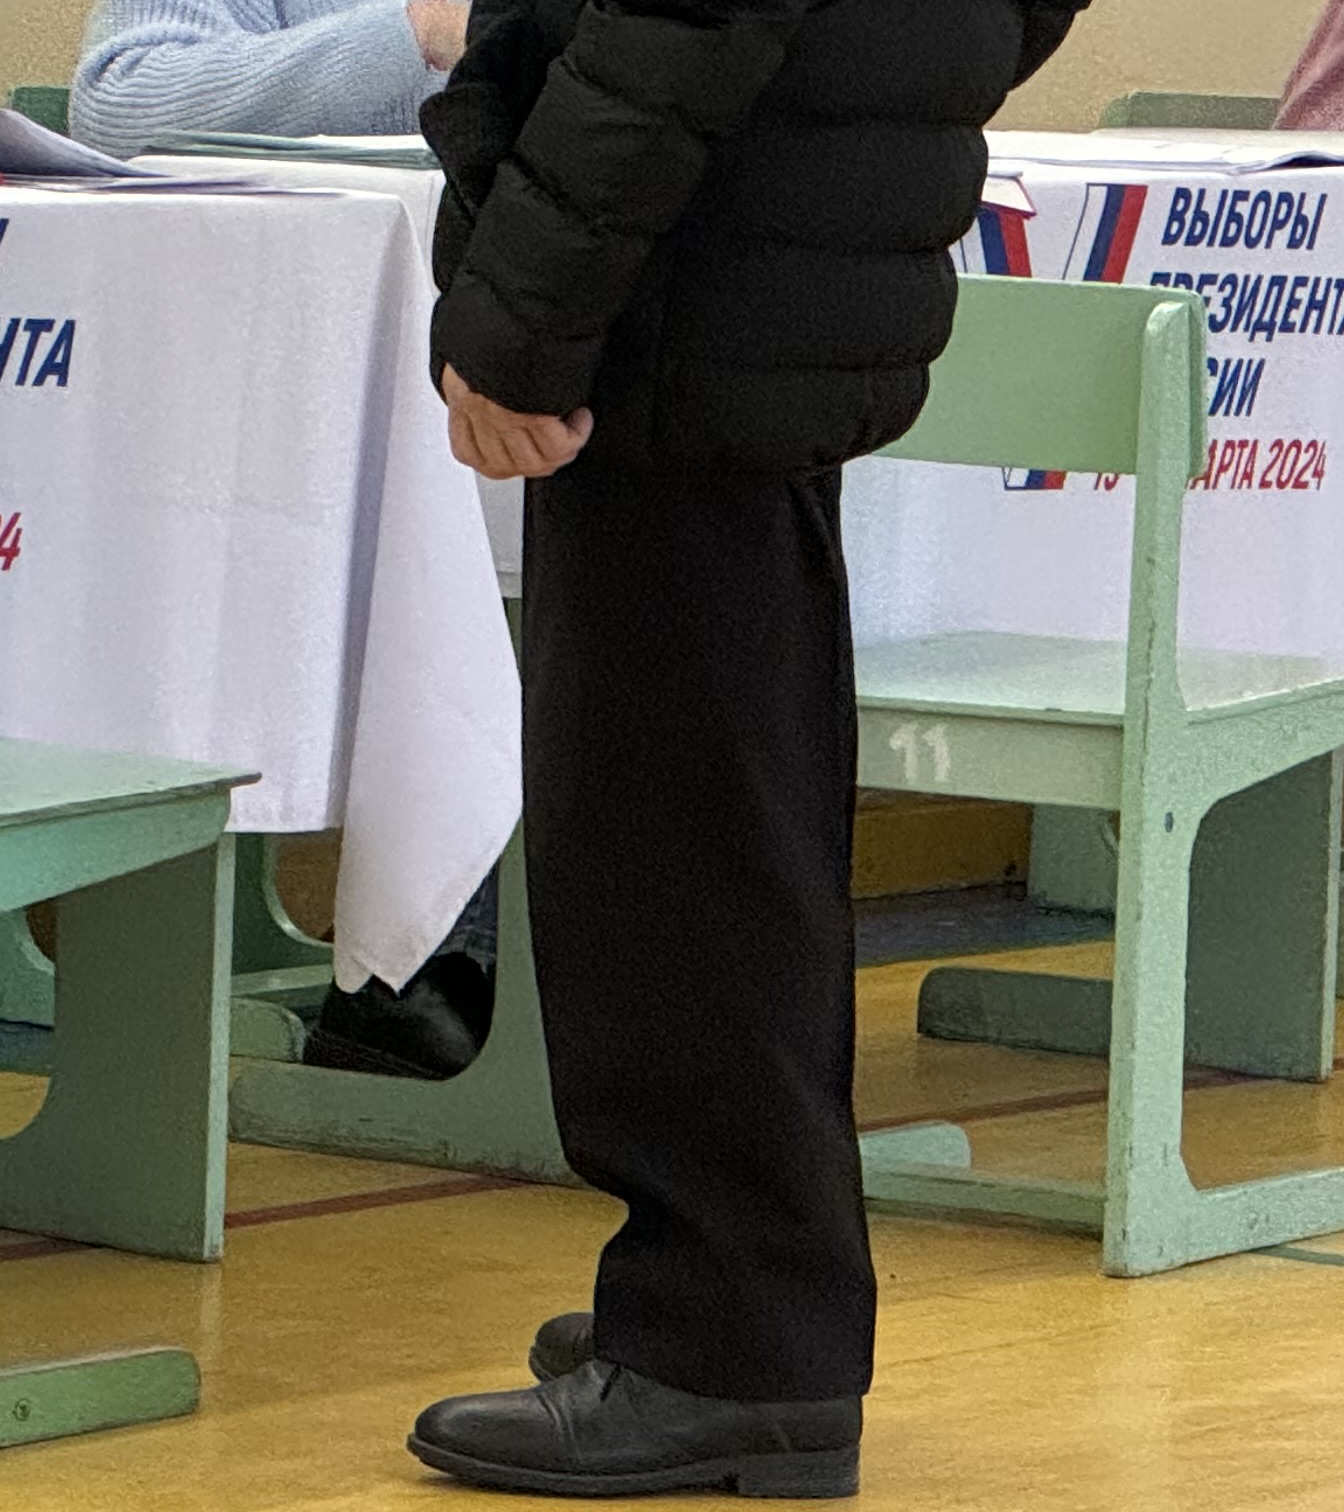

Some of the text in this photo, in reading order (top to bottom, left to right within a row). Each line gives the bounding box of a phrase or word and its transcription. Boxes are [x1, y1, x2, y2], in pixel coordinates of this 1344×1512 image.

[1161, 186, 1328, 251] ВЫБОРЫ
[1184, 438, 1327, 490] АРТА 2024
[889, 722, 951, 783] 11
